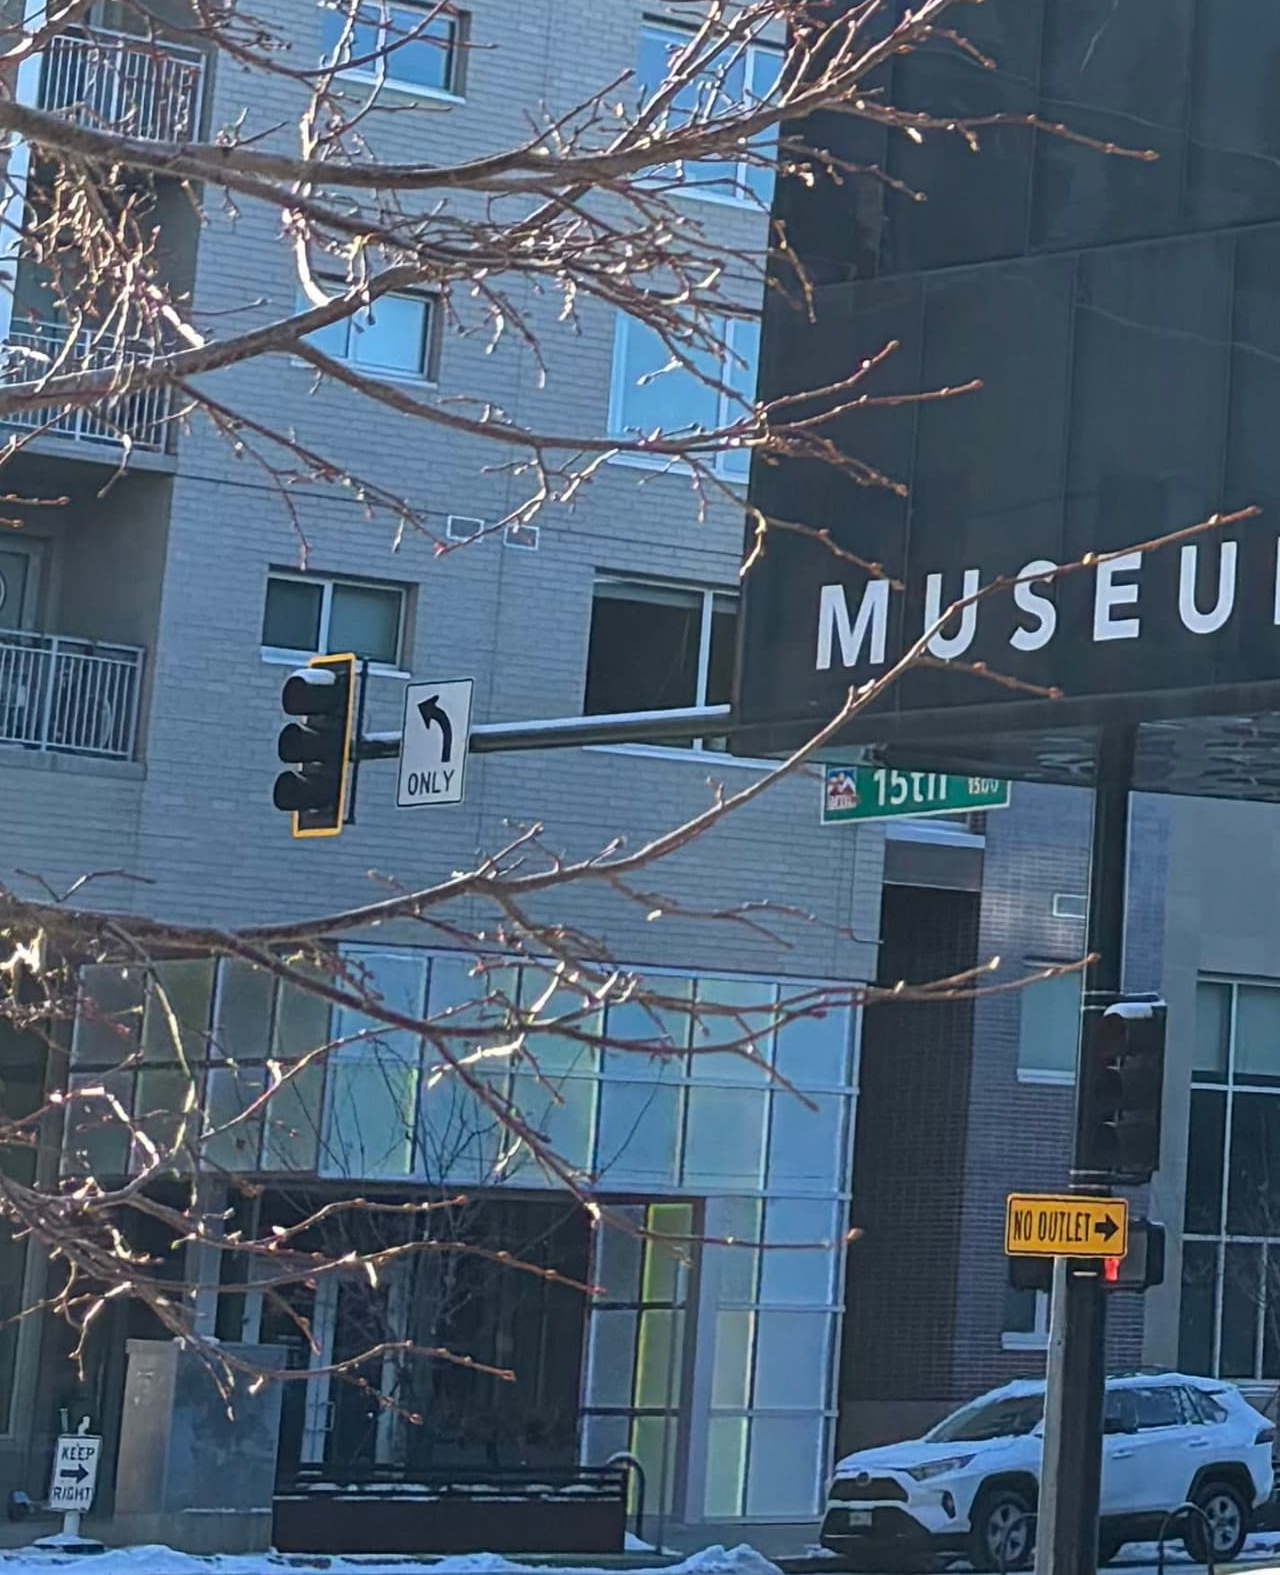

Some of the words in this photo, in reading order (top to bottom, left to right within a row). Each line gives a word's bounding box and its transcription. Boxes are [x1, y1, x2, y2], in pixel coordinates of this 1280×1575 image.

[407, 769, 455, 796] ONLY
[872, 768, 948, 807] 15th
[1013, 1209, 1033, 1242] NO
[1037, 1211, 1092, 1243] OUTLET
[62, 1446, 95, 1461] KEEP
[53, 1486, 93, 1501] RIGHT
